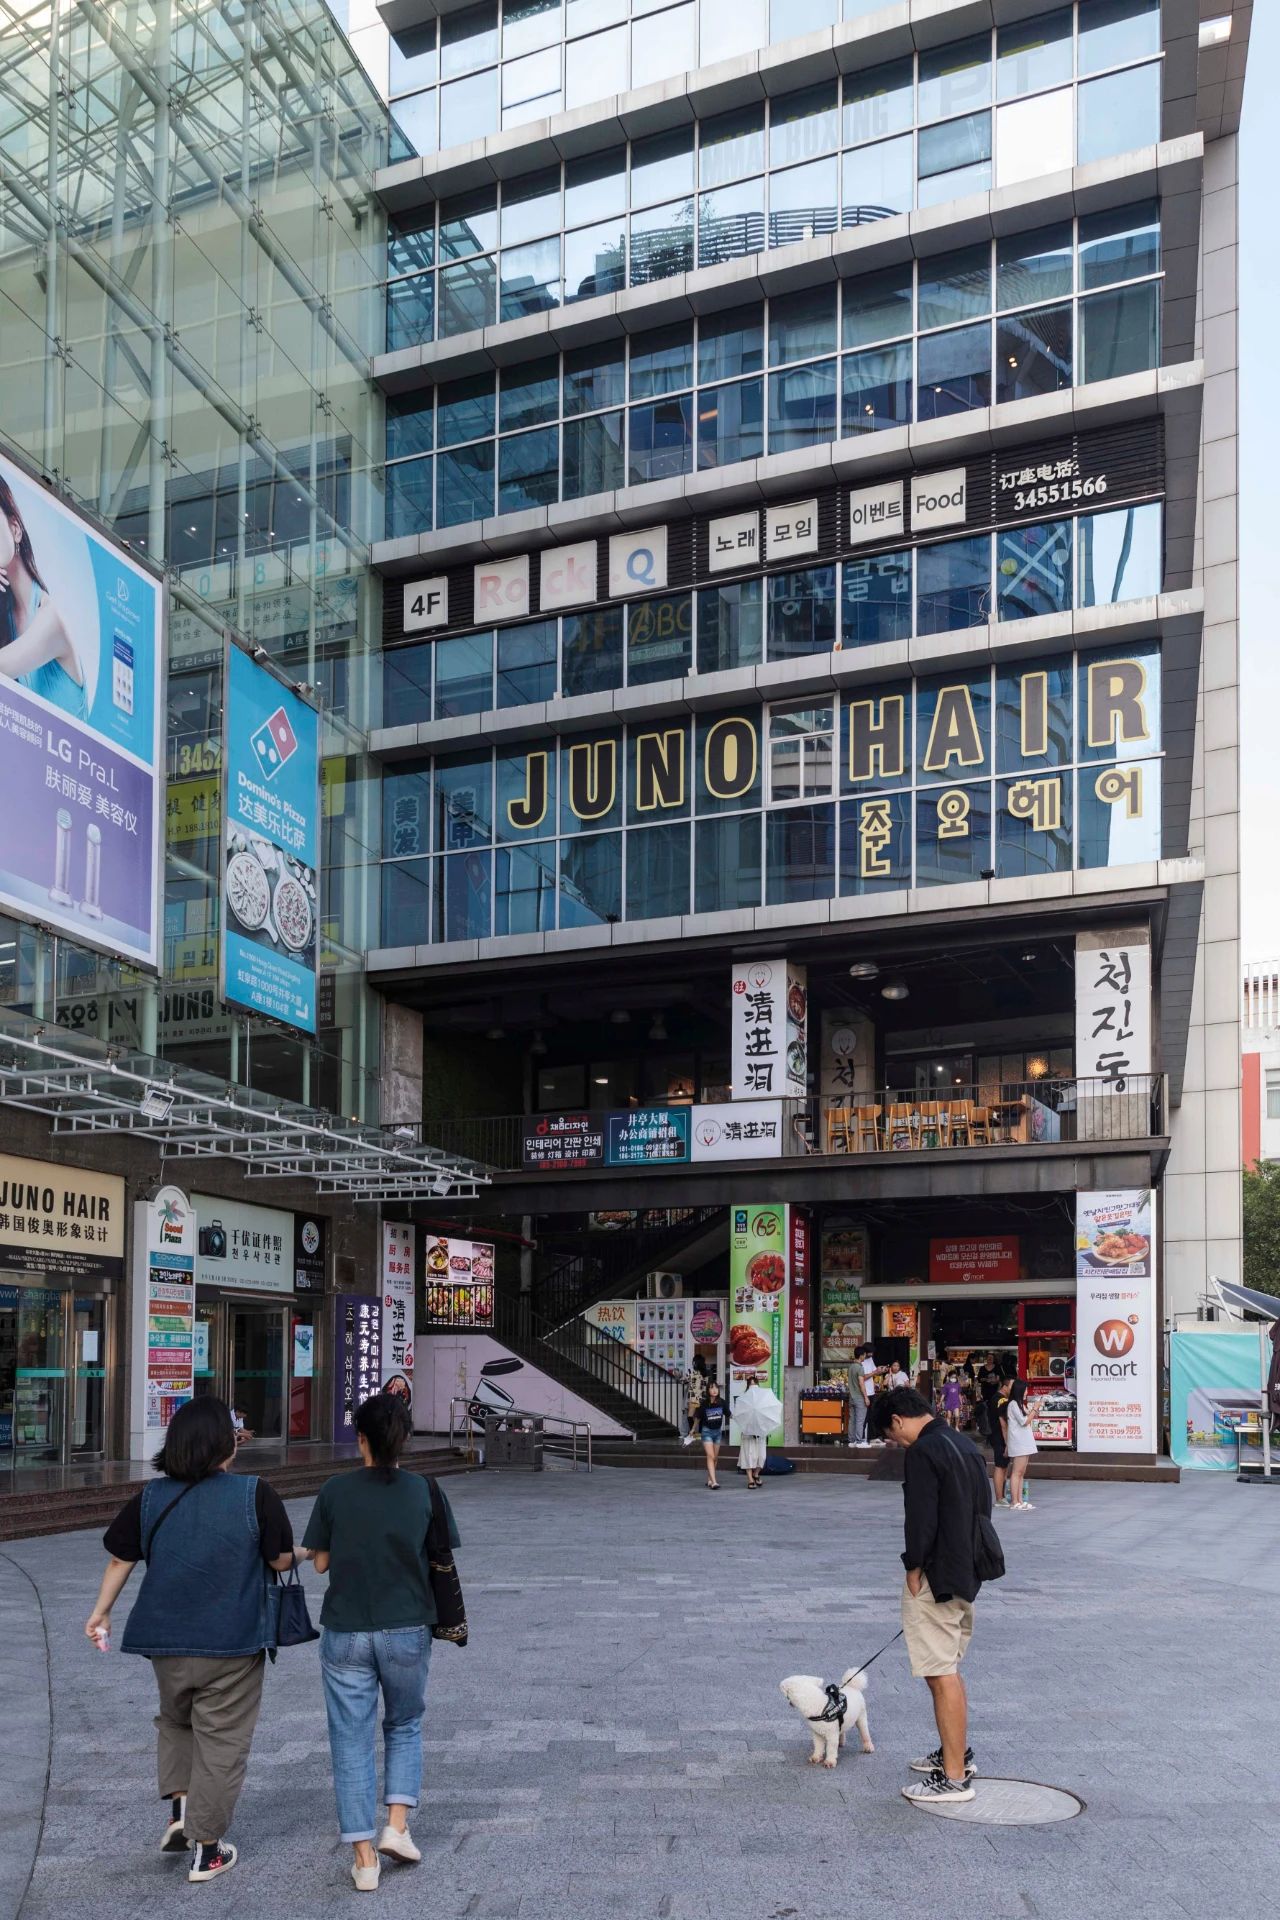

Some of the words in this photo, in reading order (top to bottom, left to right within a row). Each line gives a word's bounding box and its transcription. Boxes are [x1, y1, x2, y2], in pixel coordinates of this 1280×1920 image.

[916, 485, 964, 515] Food
[1014, 474, 1107, 511] 34551566
[852, 499, 902, 526] 이벤트
[715, 528, 755, 552] 노래
[773, 517, 811, 542] 모임
[410, 591, 441, 617] 4F
[478, 557, 589, 609] Rock
[47, 729, 72, 764] LG
[78, 748, 120, 792] Pra.L
[507, 716, 757, 830] JUNO
[848, 658, 1151, 783] HAIR
[45, 764, 93, 810] 肤丽爱
[95, 792, 138, 836] 美容仪
[237, 770, 282, 810] Domino's
[283, 800, 306, 827] Pizza
[237, 792, 306, 850] 达美乐比萨
[858, 766, 1144, 878] 준오헤어
[1091, 951, 1134, 1093] 청진동
[526, 1138, 562, 1151] 인테리어
[564, 1136, 582, 1149] 간판
[583, 1135, 602, 1147] 인쇄
[0, 1181, 55, 1214] JUNO
[63, 1191, 111, 1222] HAIR
[0, 1212, 108, 1243] 韩国俊奥形象设计
[164, 1222, 184, 1234] Seoul
[164, 1233, 182, 1244] Plaza
[597, 1306, 625, 1321] 热饮
[1099, 1329, 1129, 1351] W
[1090, 1361, 1138, 1377] mart
